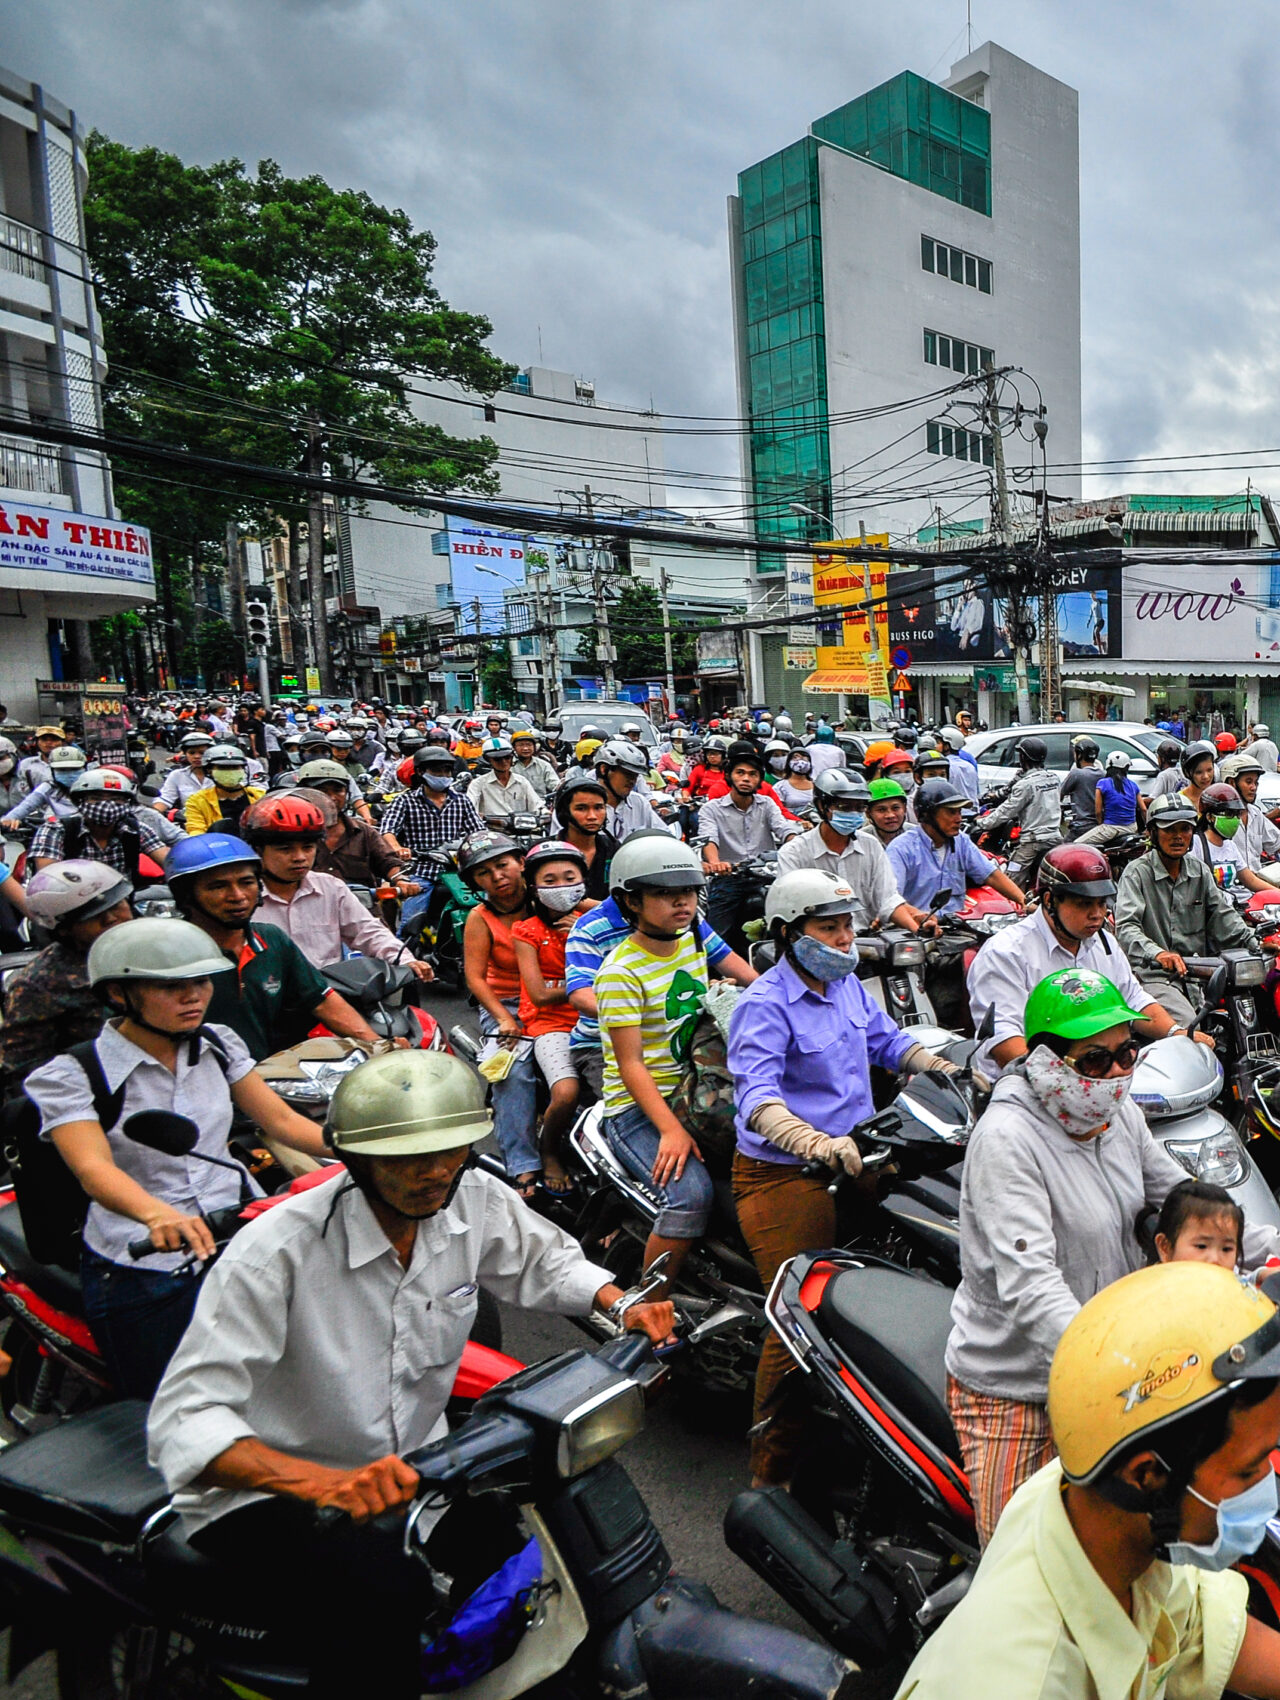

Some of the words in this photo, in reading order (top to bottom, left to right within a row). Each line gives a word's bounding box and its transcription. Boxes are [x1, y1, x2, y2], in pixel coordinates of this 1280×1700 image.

[63, 521, 150, 556] THIÊN
[452, 540, 503, 557] HIỀN
[1136, 592, 1235, 620] wow
[890, 631, 910, 641] BUSS
[913, 630, 934, 640] FIGO
